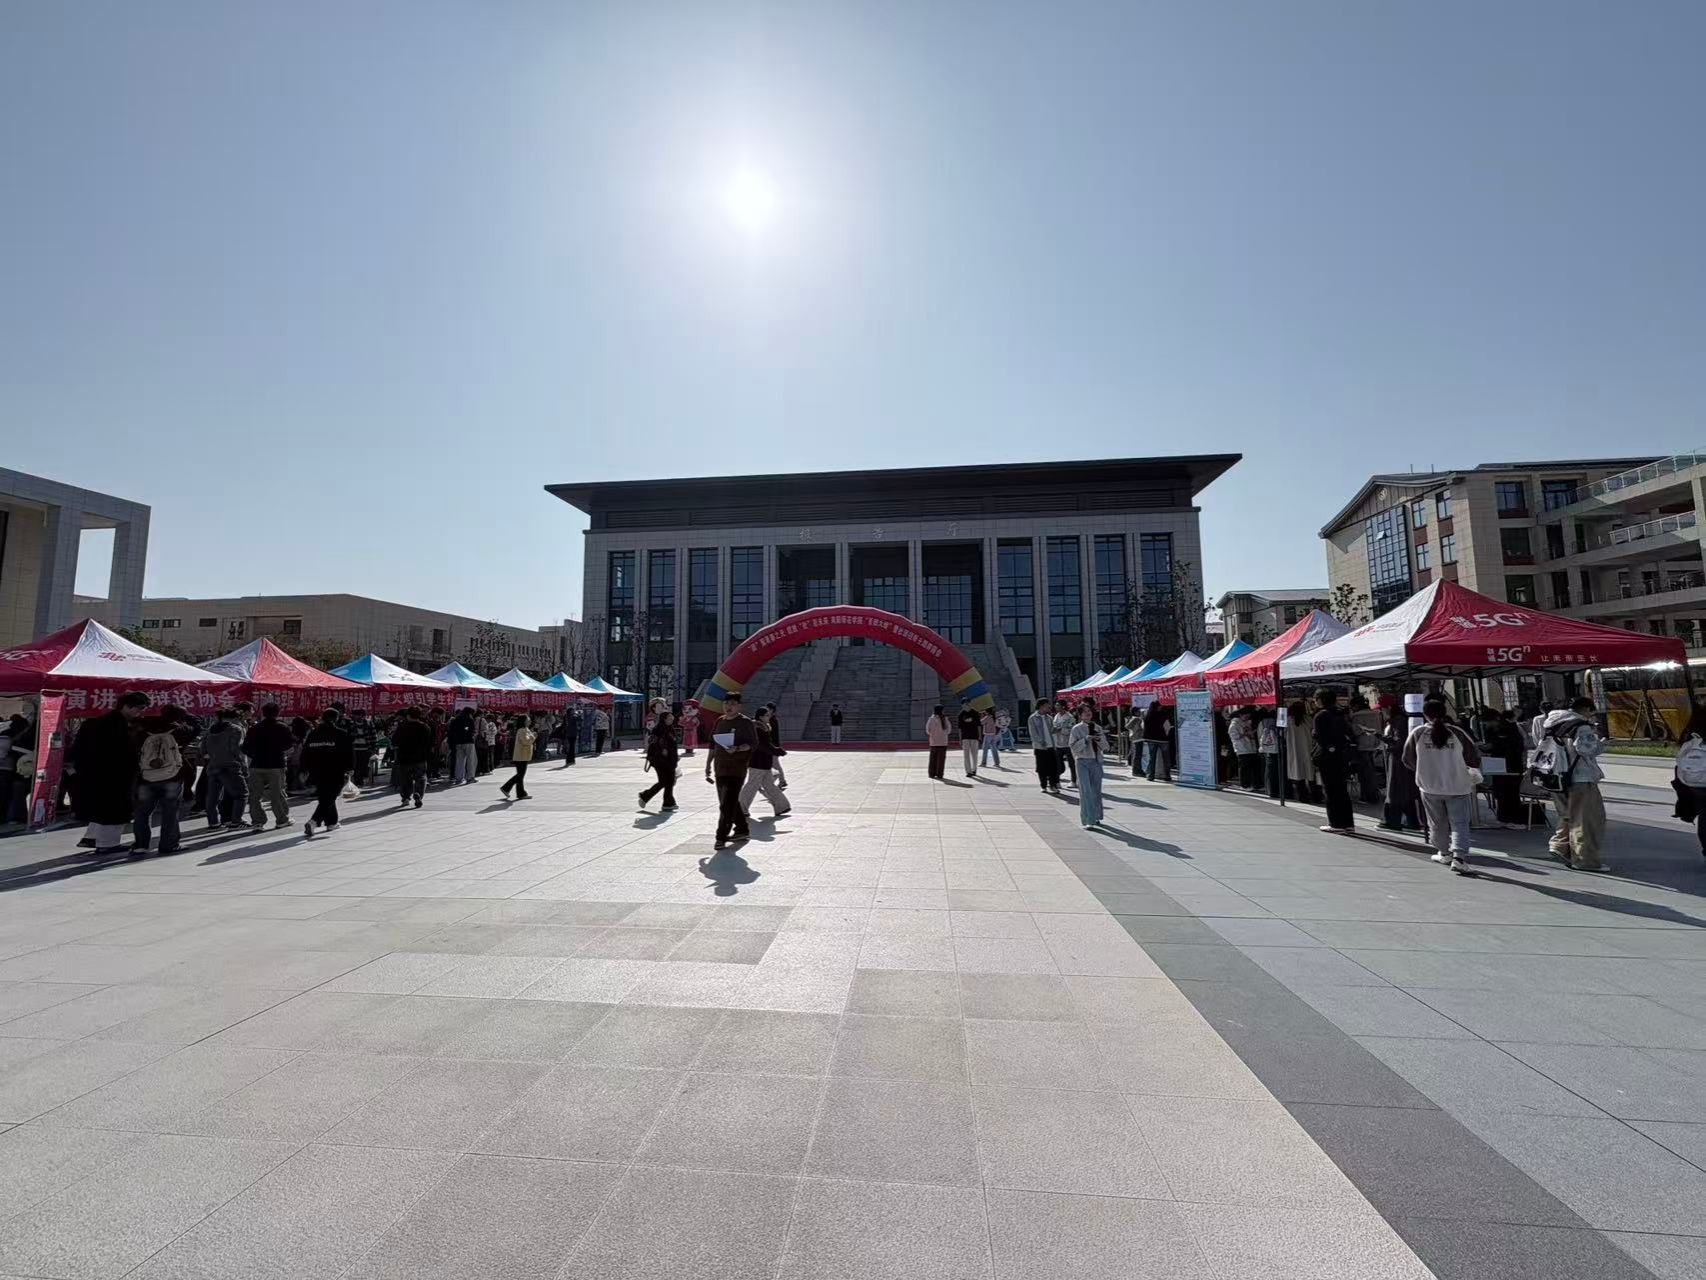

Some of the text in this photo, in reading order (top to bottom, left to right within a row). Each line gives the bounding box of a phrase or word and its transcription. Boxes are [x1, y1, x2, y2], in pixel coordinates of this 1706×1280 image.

[64, 688, 234, 710] 演讲辩论协会
